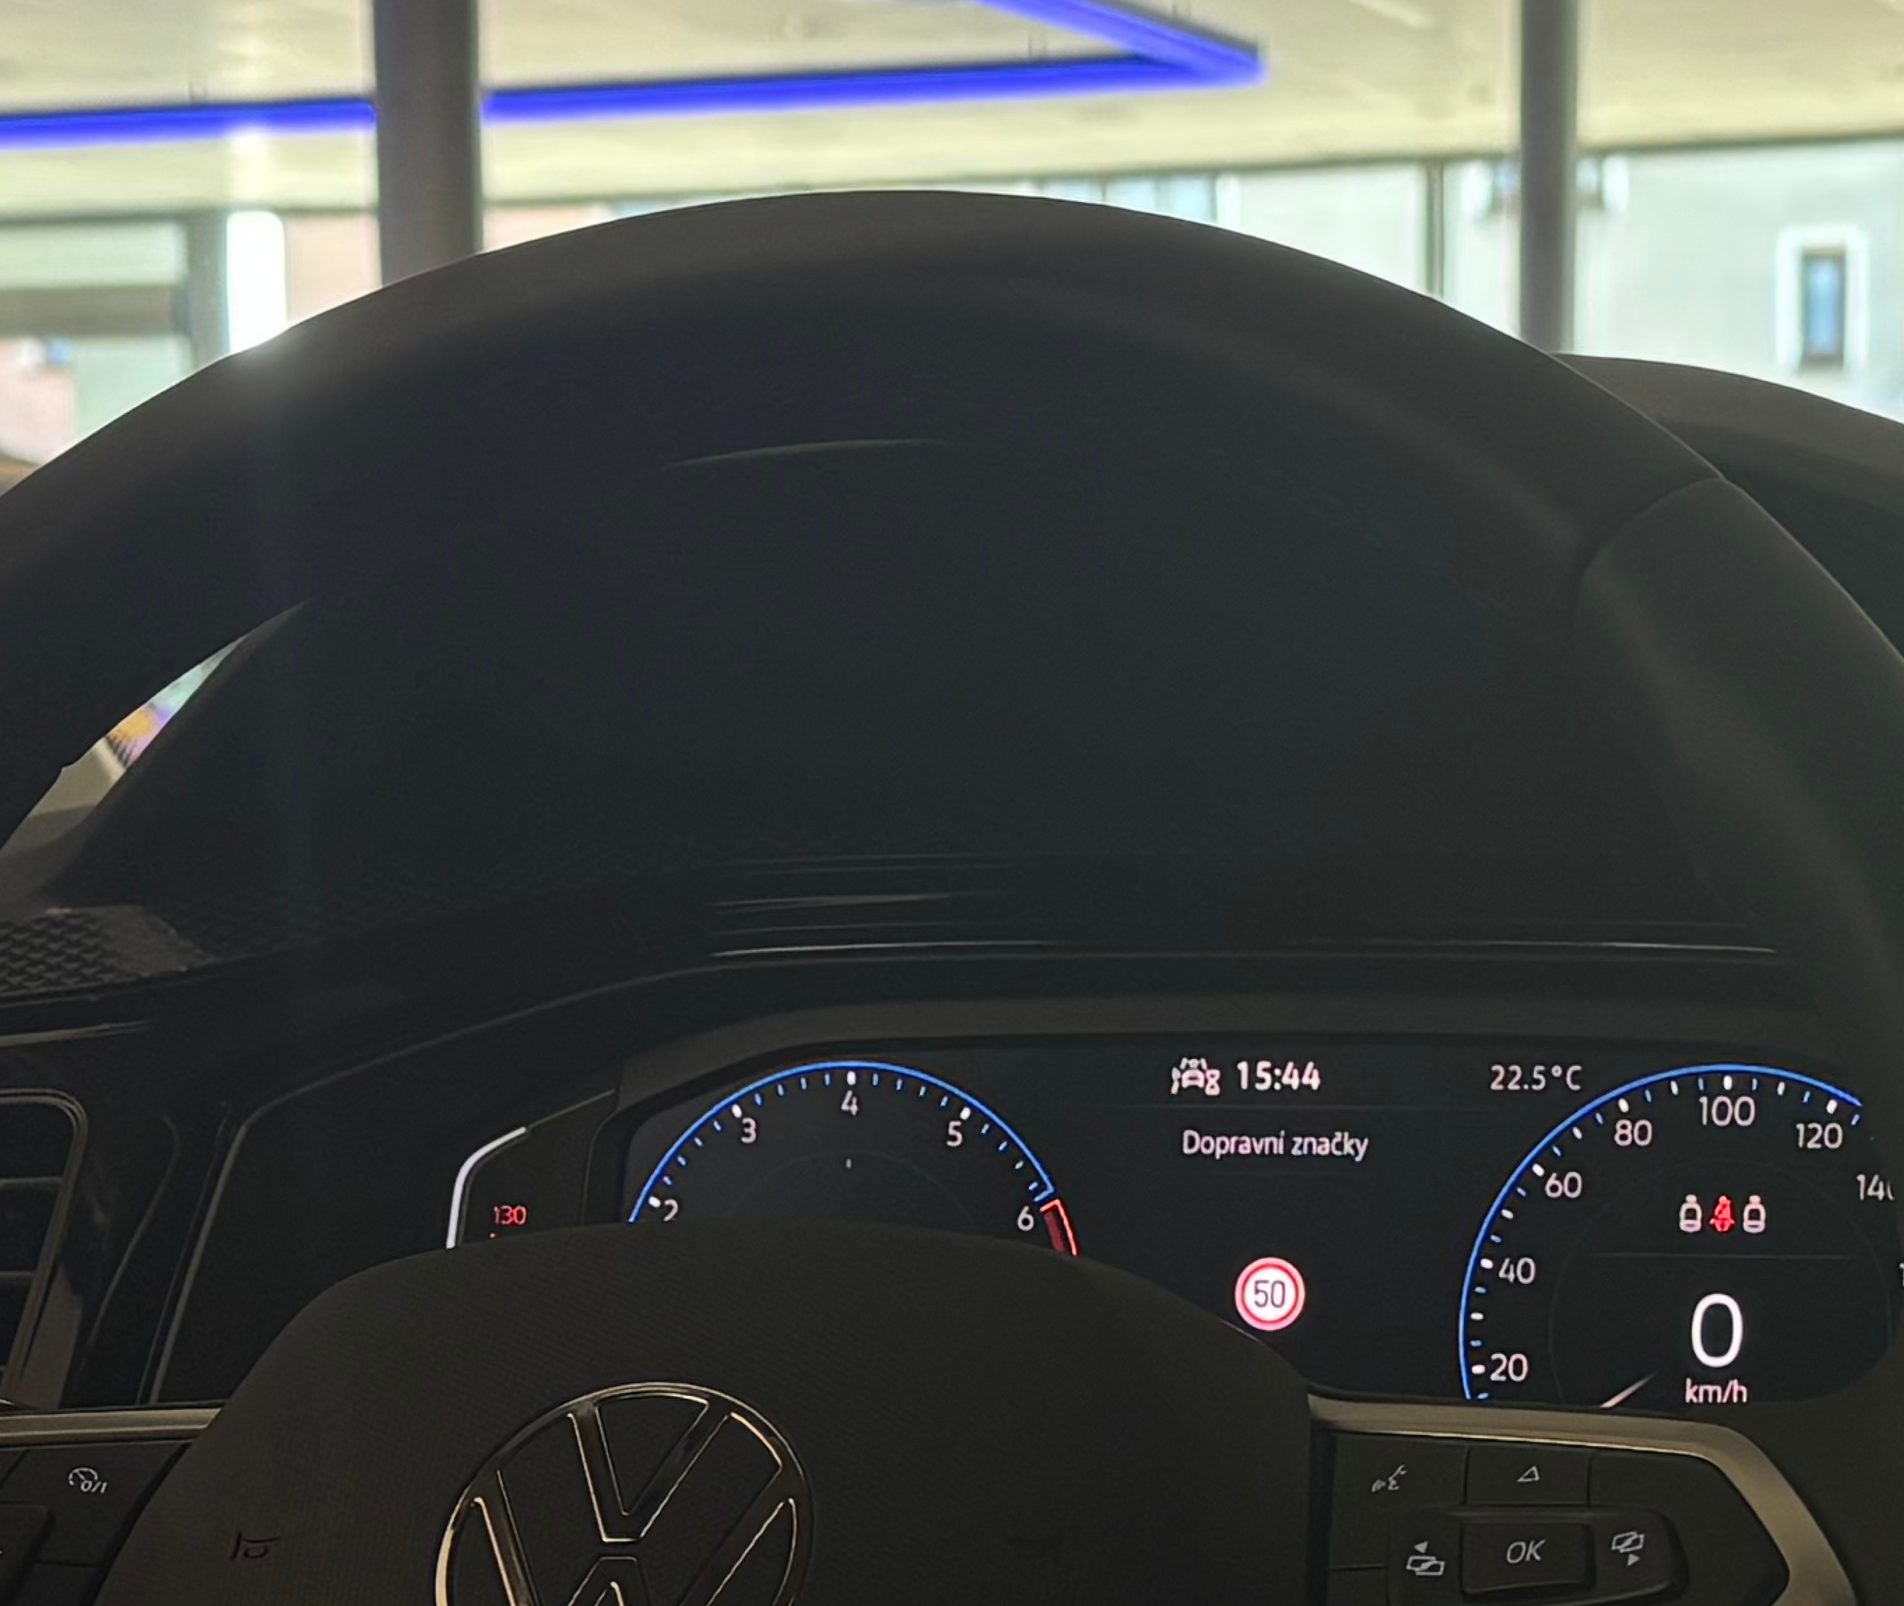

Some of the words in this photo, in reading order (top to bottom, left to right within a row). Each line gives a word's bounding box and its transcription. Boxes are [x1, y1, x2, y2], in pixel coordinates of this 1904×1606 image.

[1236, 1060, 1321, 1091] 15:44
[1490, 1064, 1583, 1091] 22.5°C
[840, 1090, 859, 1116] 4
[1699, 1096, 1756, 1127] 100
[741, 1118, 757, 1144] 3
[946, 1120, 964, 1147] 5
[1614, 1119, 1653, 1148] 80
[1795, 1122, 1843, 1149] 120
[1182, 1129, 1285, 1160] Dopravní
[1291, 1131, 1369, 1162] značky
[1545, 1172, 1583, 1199] 60
[493, 1205, 527, 1225] 130
[664, 1198, 679, 1222] 2
[1017, 1205, 1035, 1232] 6
[1498, 1257, 1536, 1285] 40
[1253, 1280, 1286, 1310] 50
[1691, 1293, 1744, 1368] 0
[1490, 1354, 1529, 1383] 20
[1685, 1377, 1748, 1405] km/h
[1506, 1539, 1545, 1564] OK
